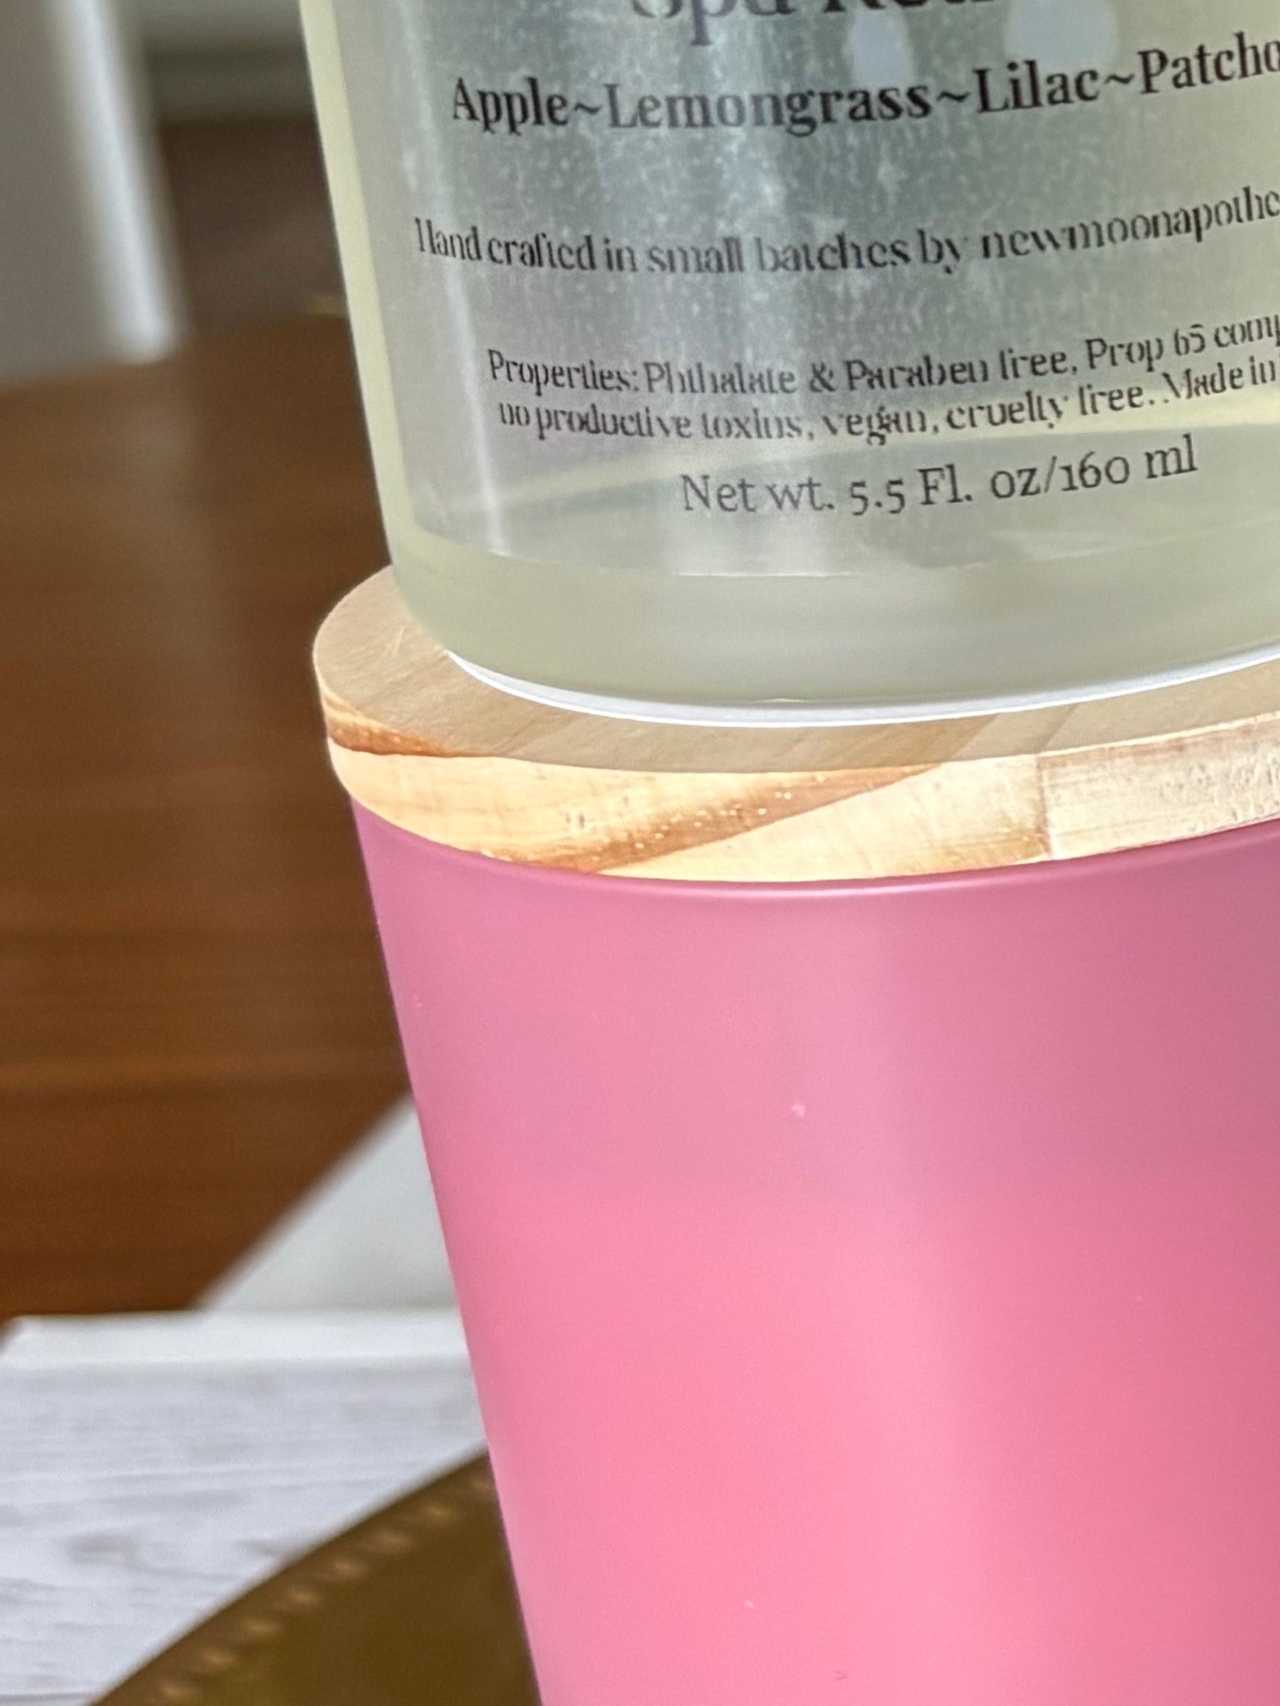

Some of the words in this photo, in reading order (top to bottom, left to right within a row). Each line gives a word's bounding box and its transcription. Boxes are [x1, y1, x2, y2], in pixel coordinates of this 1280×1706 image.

[414, 216, 483, 263] Hand
[487, 232, 597, 272] crafted
[603, 237, 639, 273] in
[647, 236, 745, 274] small
[755, 231, 910, 273] batches
[916, 228, 967, 275] by
[487, 348, 639, 397] Properties:
[643, 361, 798, 395] Phthalate
[809, 361, 837, 394] &
[844, 353, 989, 392] Paraben
[1085, 337, 1164, 373] Prop
[1174, 323, 1206, 357] 65
[499, 402, 531, 428] no
[536, 402, 693, 441] productive
[823, 406, 940, 447] vegan,
[946, 390, 1069, 430] cruelty
[1078, 383, 1155, 416] free.
[1162, 361, 1244, 404] Made
[1249, 354, 1277, 387] in
[680, 473, 757, 514] Net
[767, 479, 835, 513] wt.
[849, 476, 906, 517] 5.5
[917, 464, 974, 507] Fl.
[990, 451, 1131, 500] oz/160
[1144, 432, 1200, 482] ml
